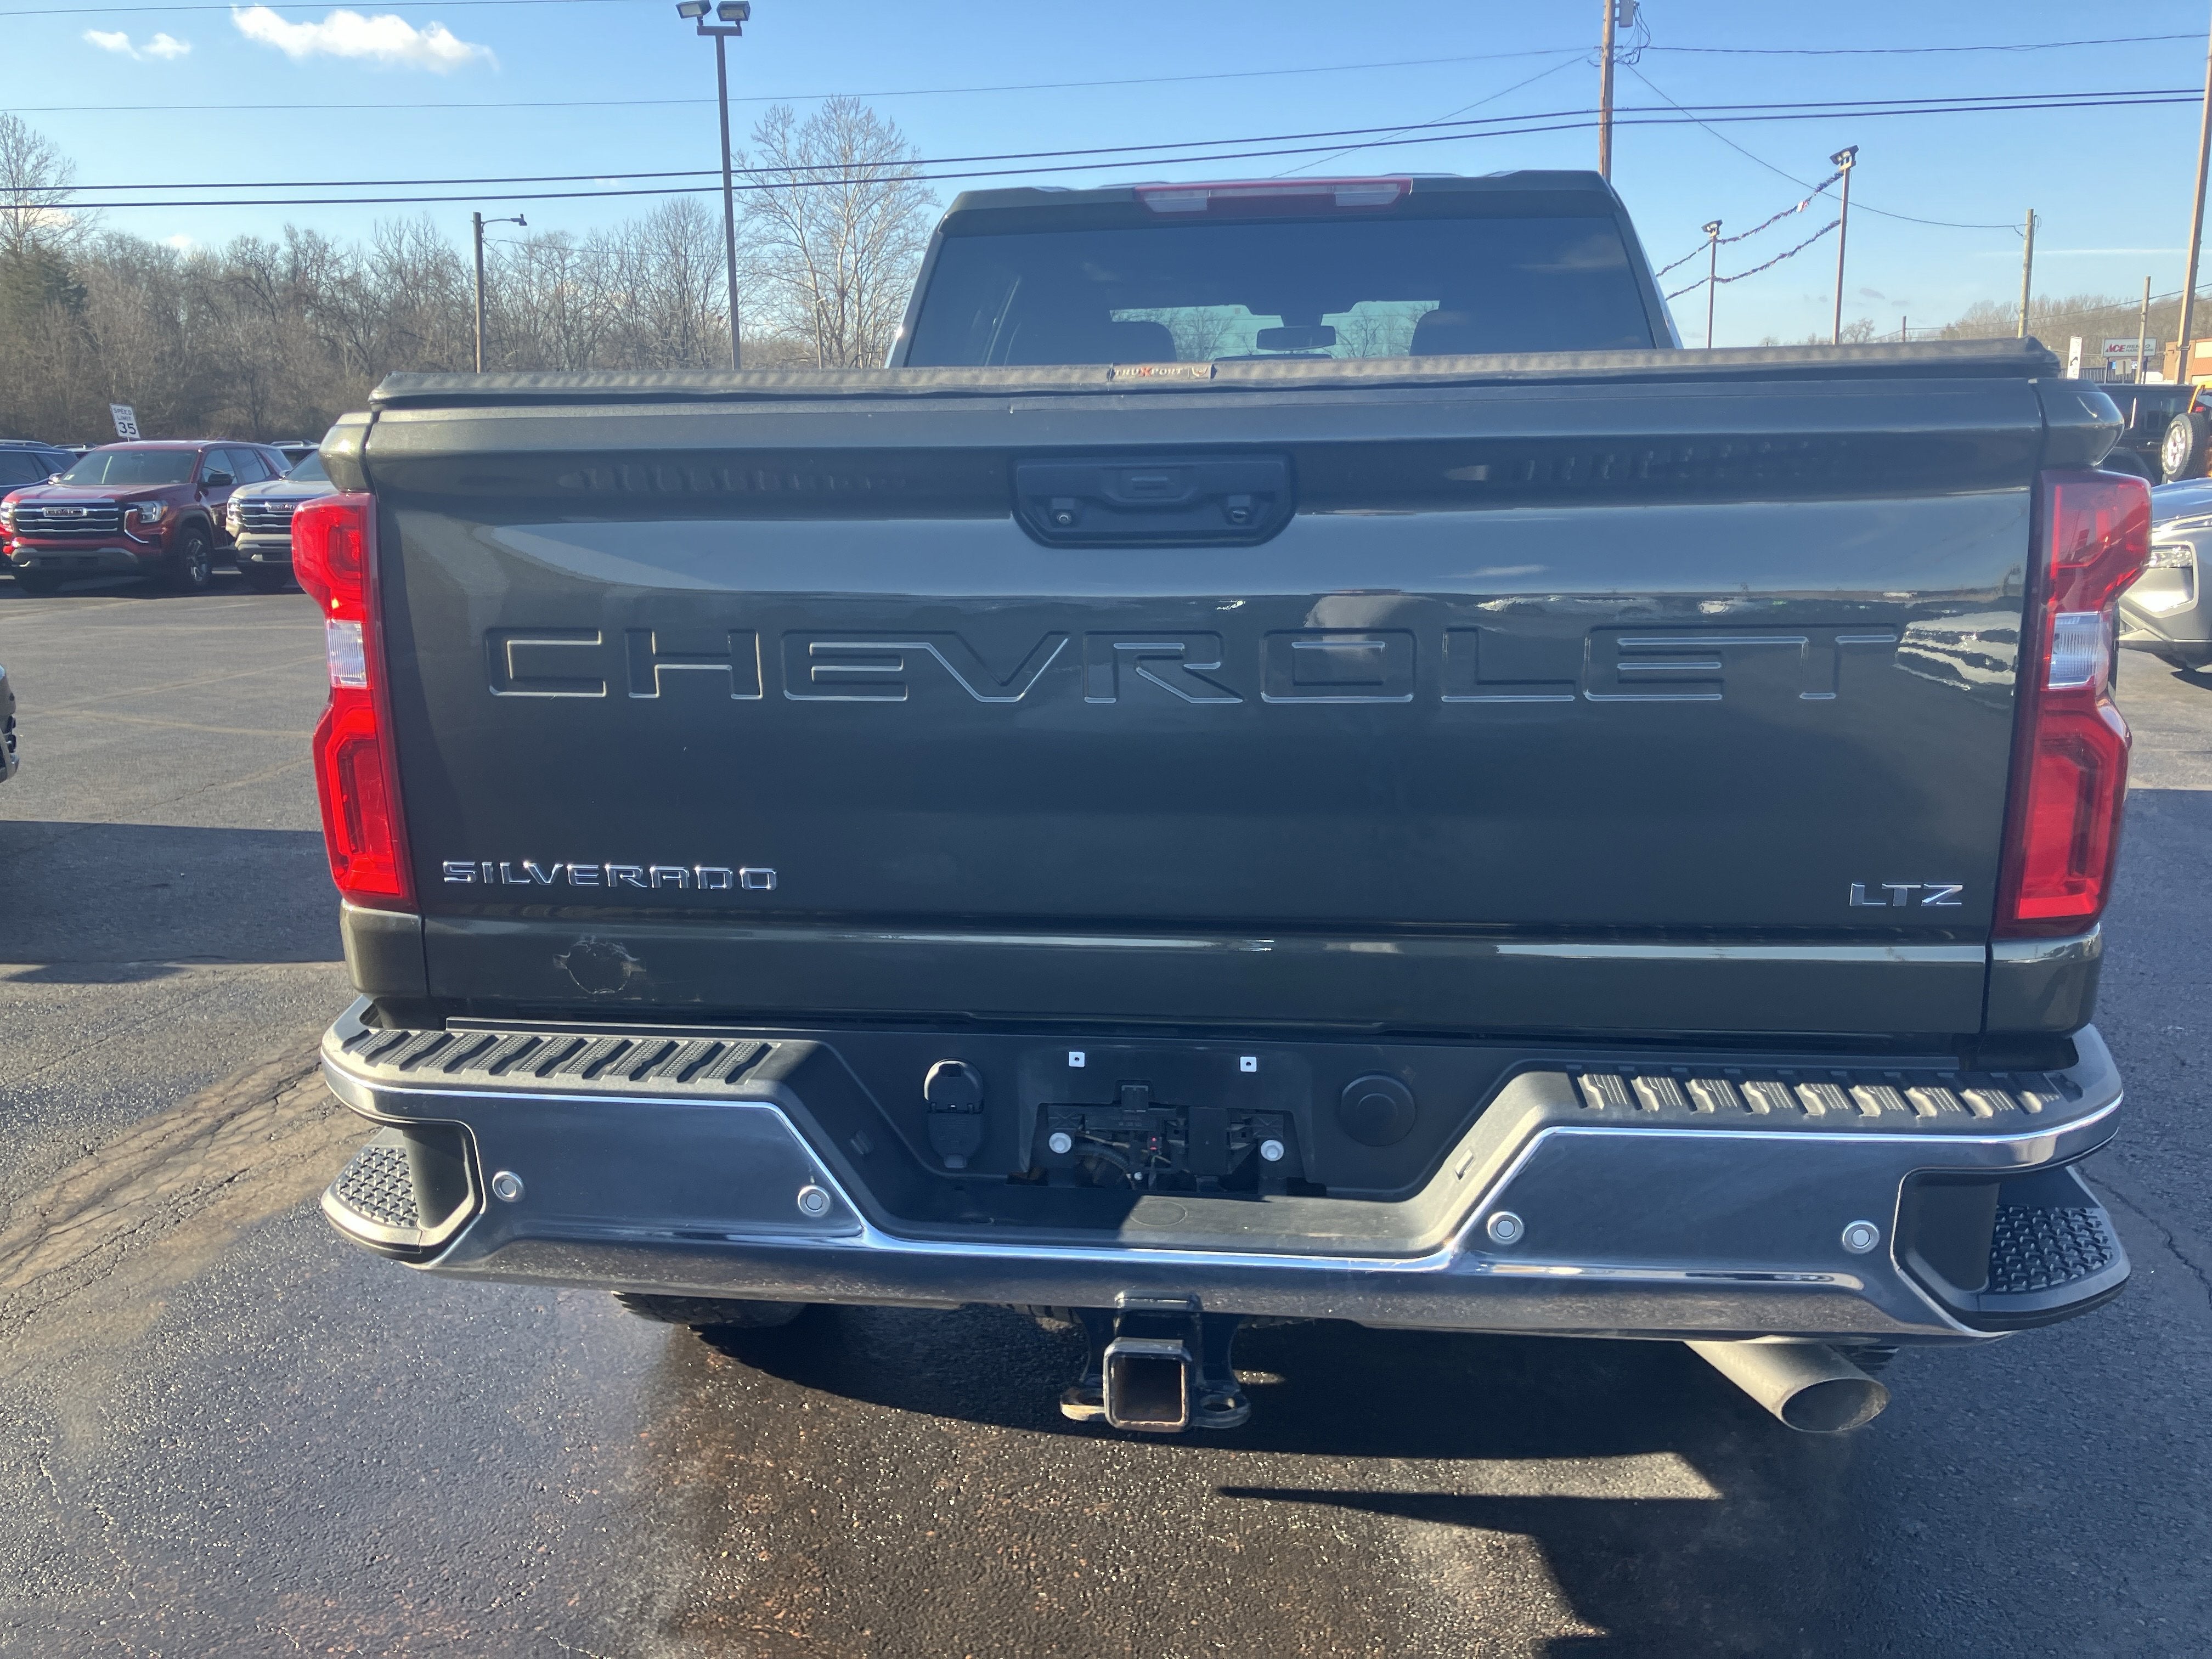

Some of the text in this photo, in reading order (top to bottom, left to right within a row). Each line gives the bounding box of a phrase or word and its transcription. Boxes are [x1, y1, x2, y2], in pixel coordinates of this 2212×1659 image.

[2106, 343, 2125, 352] ACE
[1114, 366, 1183, 377] TRUXPORT
[118, 421, 136, 435] 35
[486, 624, 1900, 704] CHEVROLET
[442, 861, 778, 891] SILVERADO
[1849, 882, 1963, 906] LTZ
